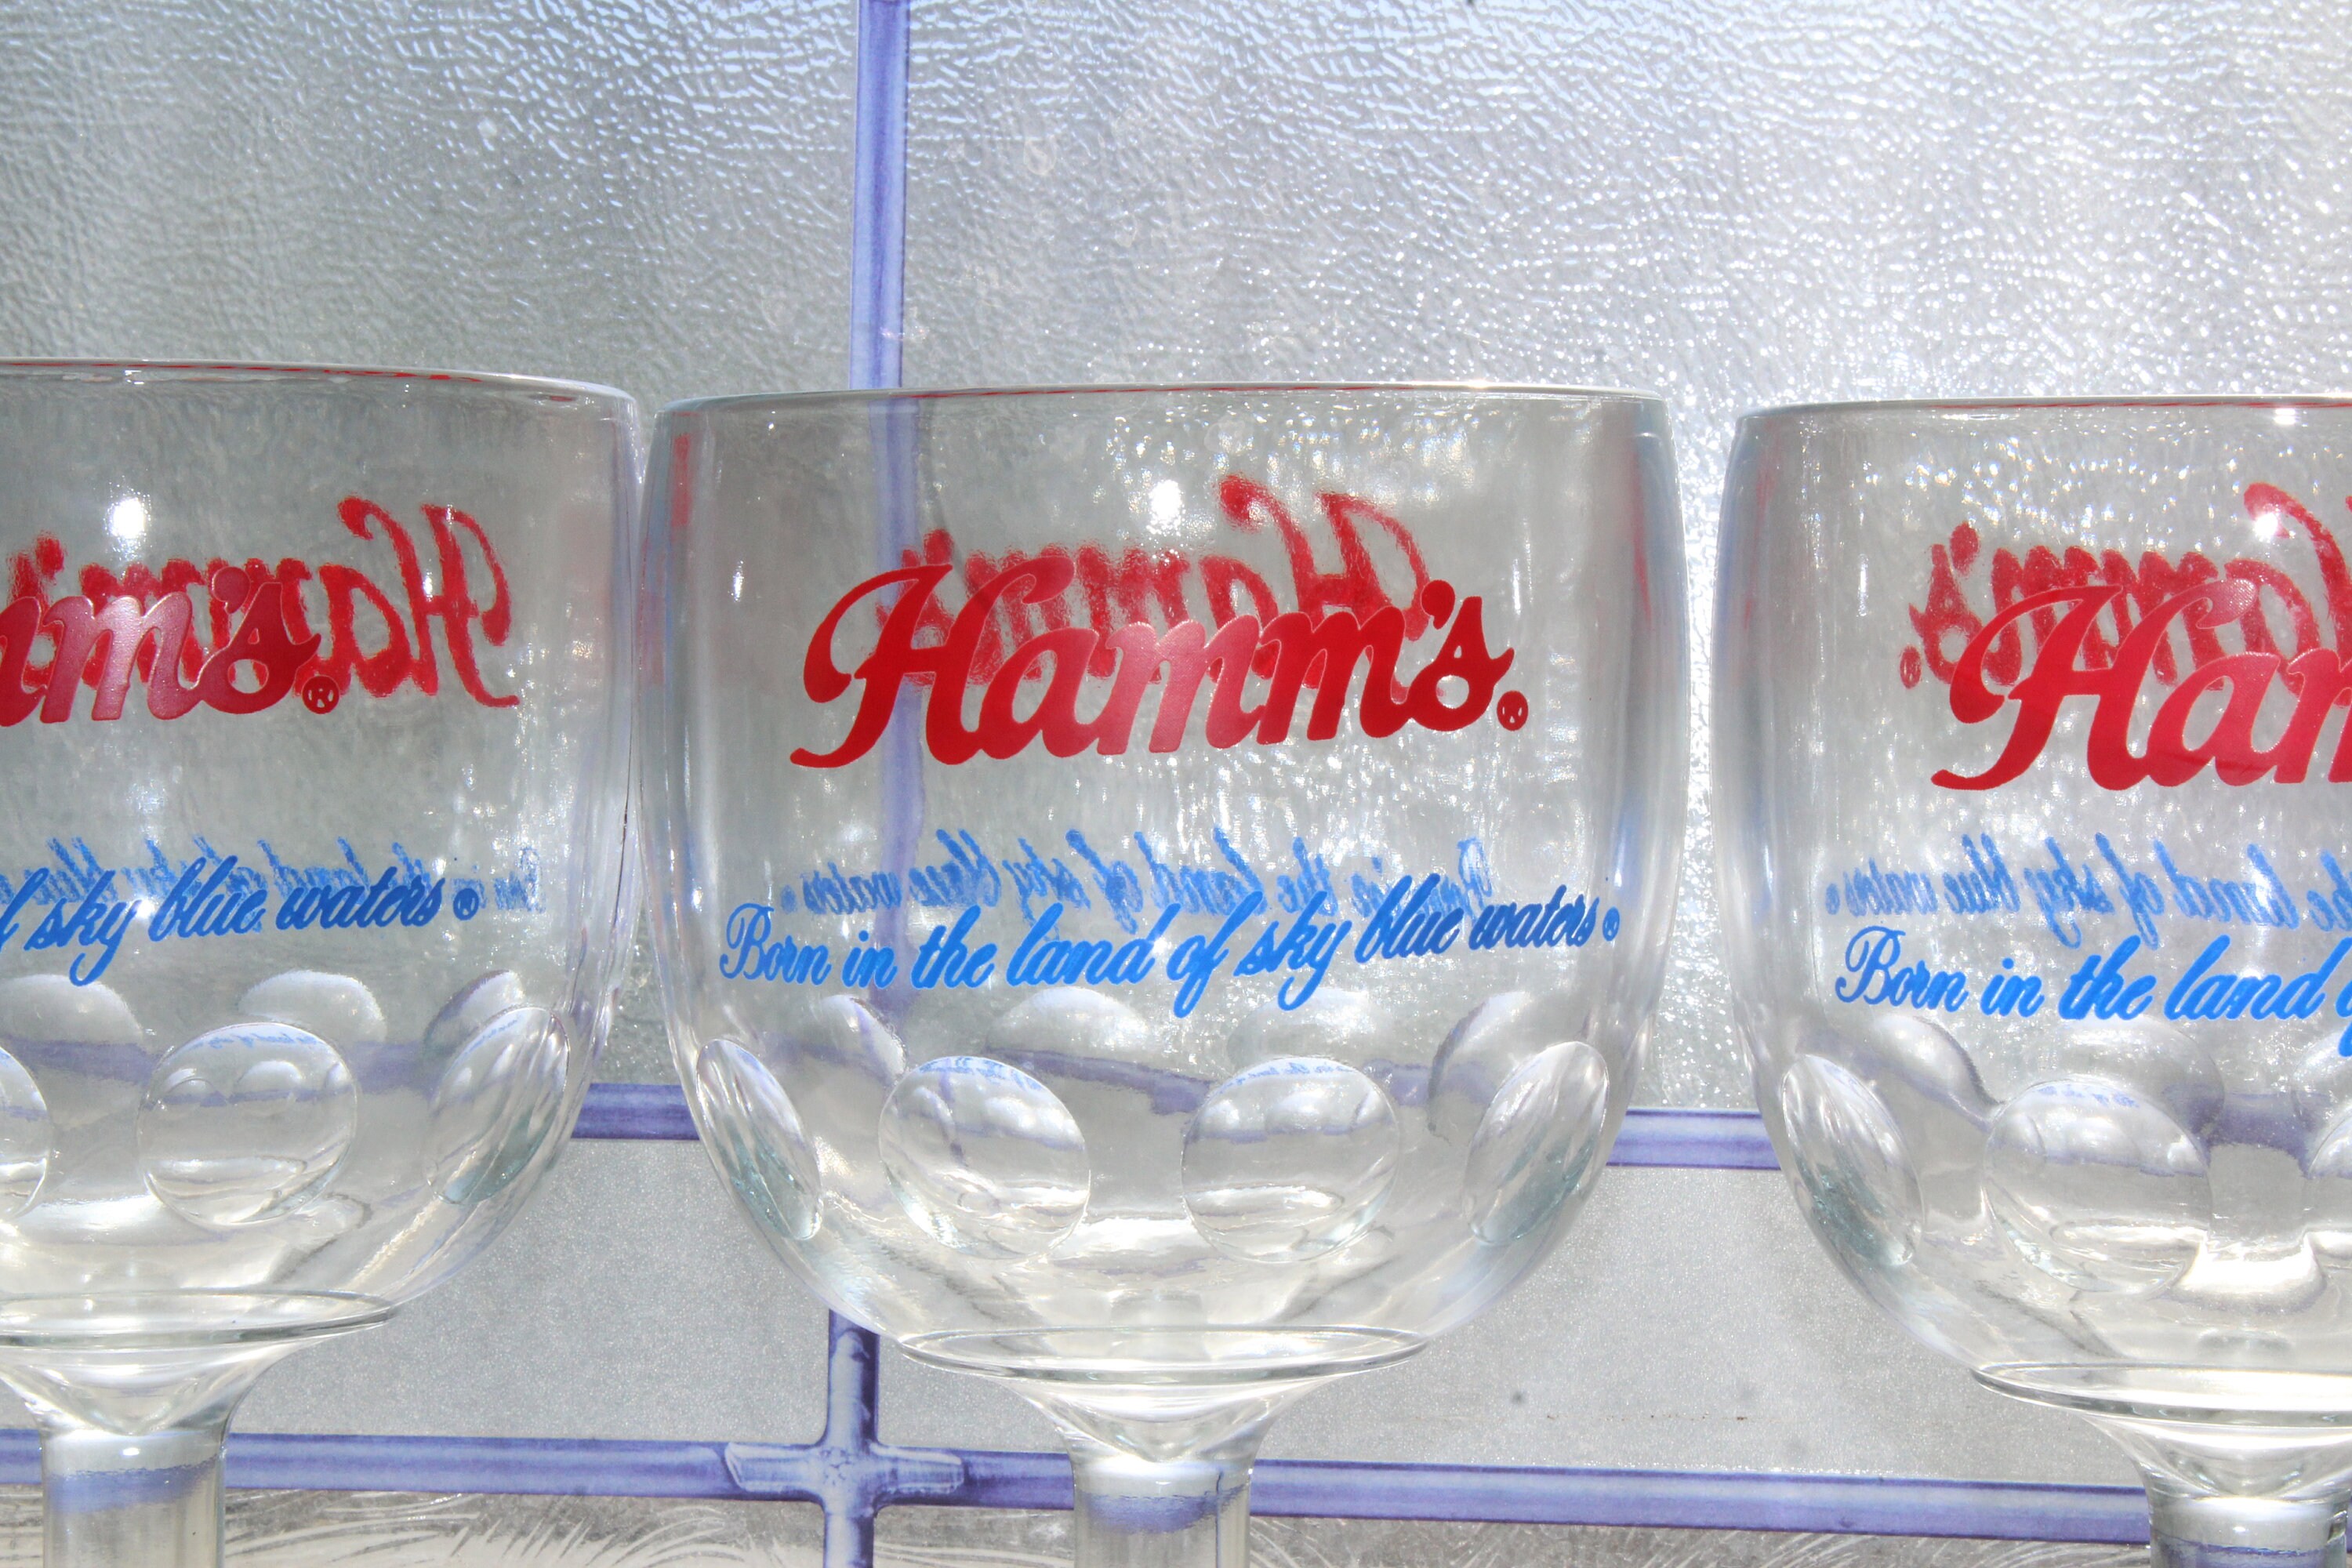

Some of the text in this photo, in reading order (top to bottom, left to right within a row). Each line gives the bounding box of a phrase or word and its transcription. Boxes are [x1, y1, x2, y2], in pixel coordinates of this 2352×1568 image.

[789, 556, 1515, 768] Hamm's
[24, 870, 141, 986] sky
[148, 856, 267, 941] blue
[275, 866, 445, 930] waters
[720, 903, 830, 985] Born
[841, 931, 898, 989] in
[911, 905, 997, 989] the
[1007, 903, 1181, 985] land
[1167, 891, 1262, 1018] of
[1234, 891, 1352, 1010] sky
[1355, 873, 1465, 963] blue
[1468, 884, 1600, 949] waters
[1835, 925, 1969, 1011] Born
[1980, 957, 2045, 1018] in
[2059, 935, 2157, 1019] the
[2164, 935, 2352, 1019] land
